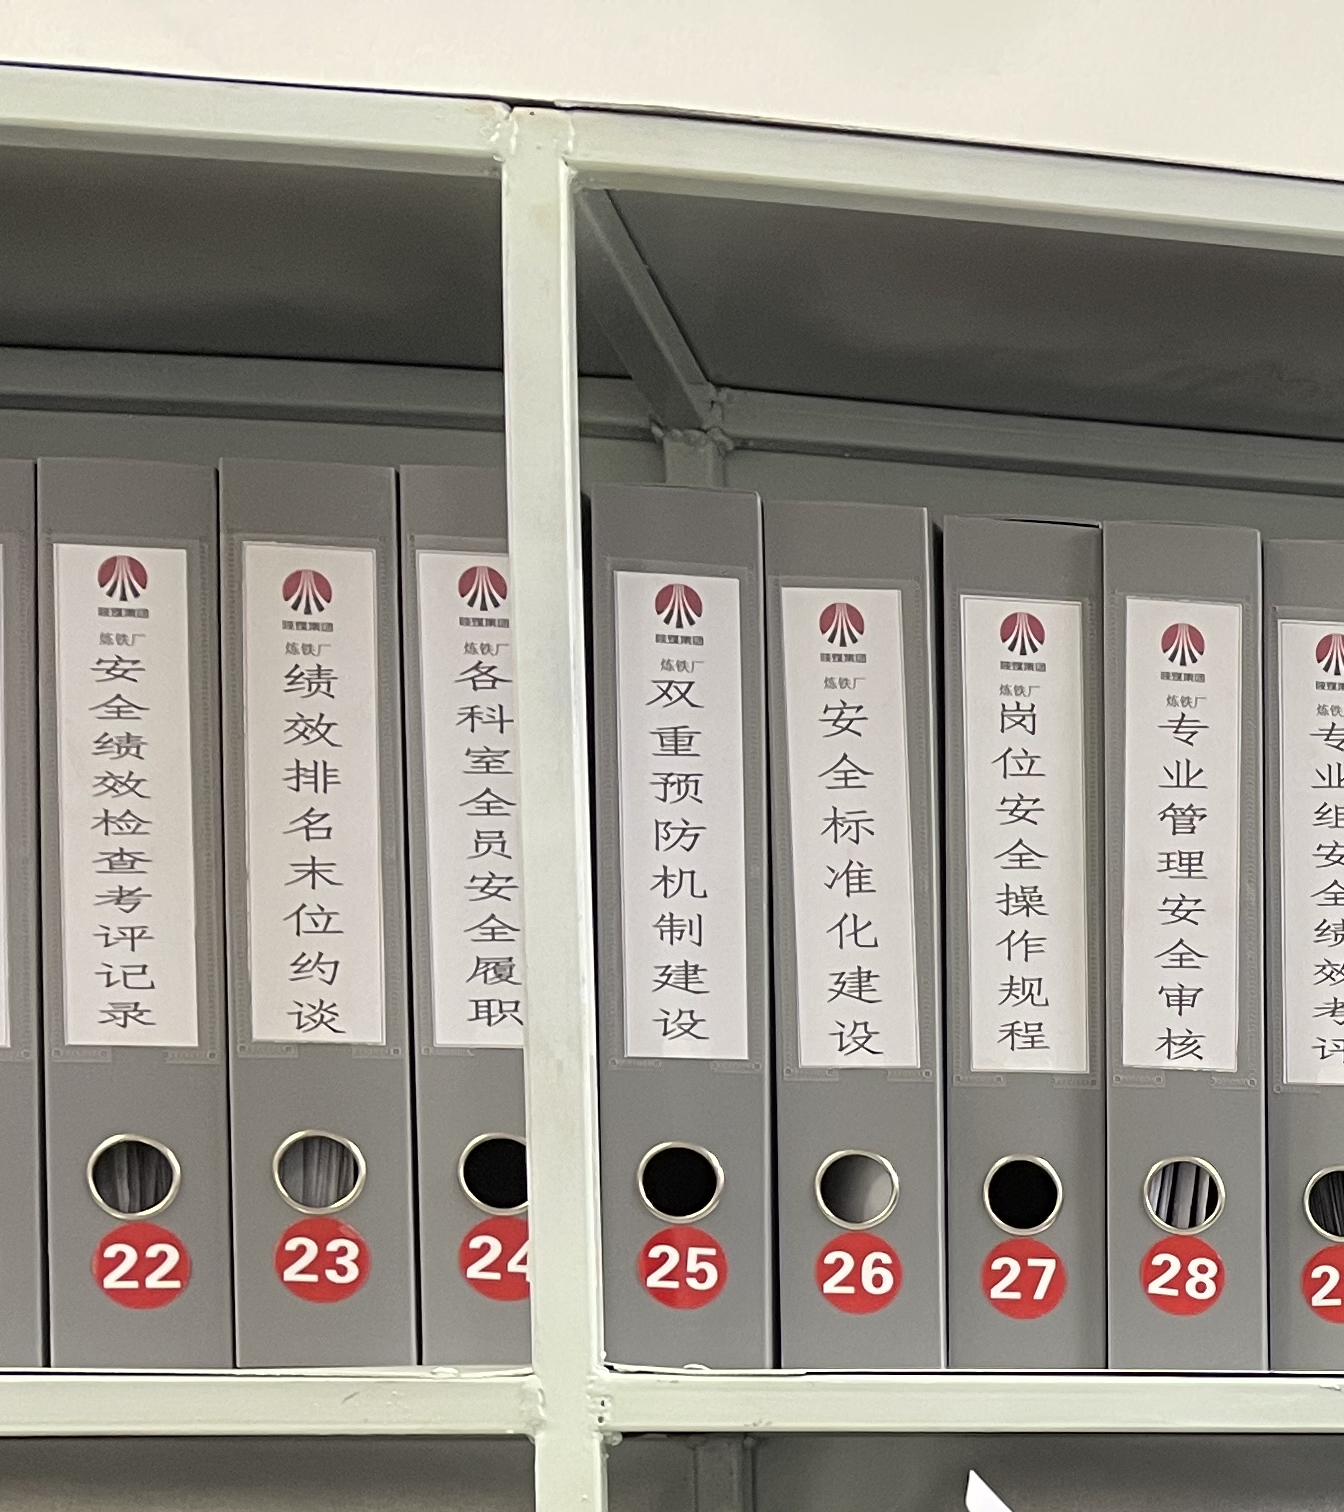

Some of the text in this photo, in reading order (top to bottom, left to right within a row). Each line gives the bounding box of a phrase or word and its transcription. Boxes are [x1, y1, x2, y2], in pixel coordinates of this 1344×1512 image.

[100, 632, 145, 646] 炼铁厂
[285, 642, 330, 656] 炼铁厂
[661, 659, 704, 673] 炼铁厂
[824, 677, 865, 689] 炼铁厂
[1000, 684, 1040, 697] 炼铁厂
[1167, 695, 1206, 708] 炼铁厂
[89, 655, 156, 1028] 安全绩效检查考评记录
[283, 664, 346, 1033] 绩效排名末位约谈
[454, 660, 524, 1027] 各科室全员安全履职
[646, 680, 709, 1039] 双重预防机制建设
[818, 699, 883, 1055] 安全标准化建设
[992, 701, 1049, 1051] 岗位安全操作规程
[1155, 712, 1209, 1060] 专业管理安全审核
[104, 1244, 180, 1288] 22
[284, 1237, 358, 1283] 23
[466, 1234, 531, 1282] 24
[647, 1245, 717, 1290] 25
[823, 1251, 893, 1294] 26
[991, 1257, 1055, 1299] 27
[1148, 1254, 1217, 1299] 28
